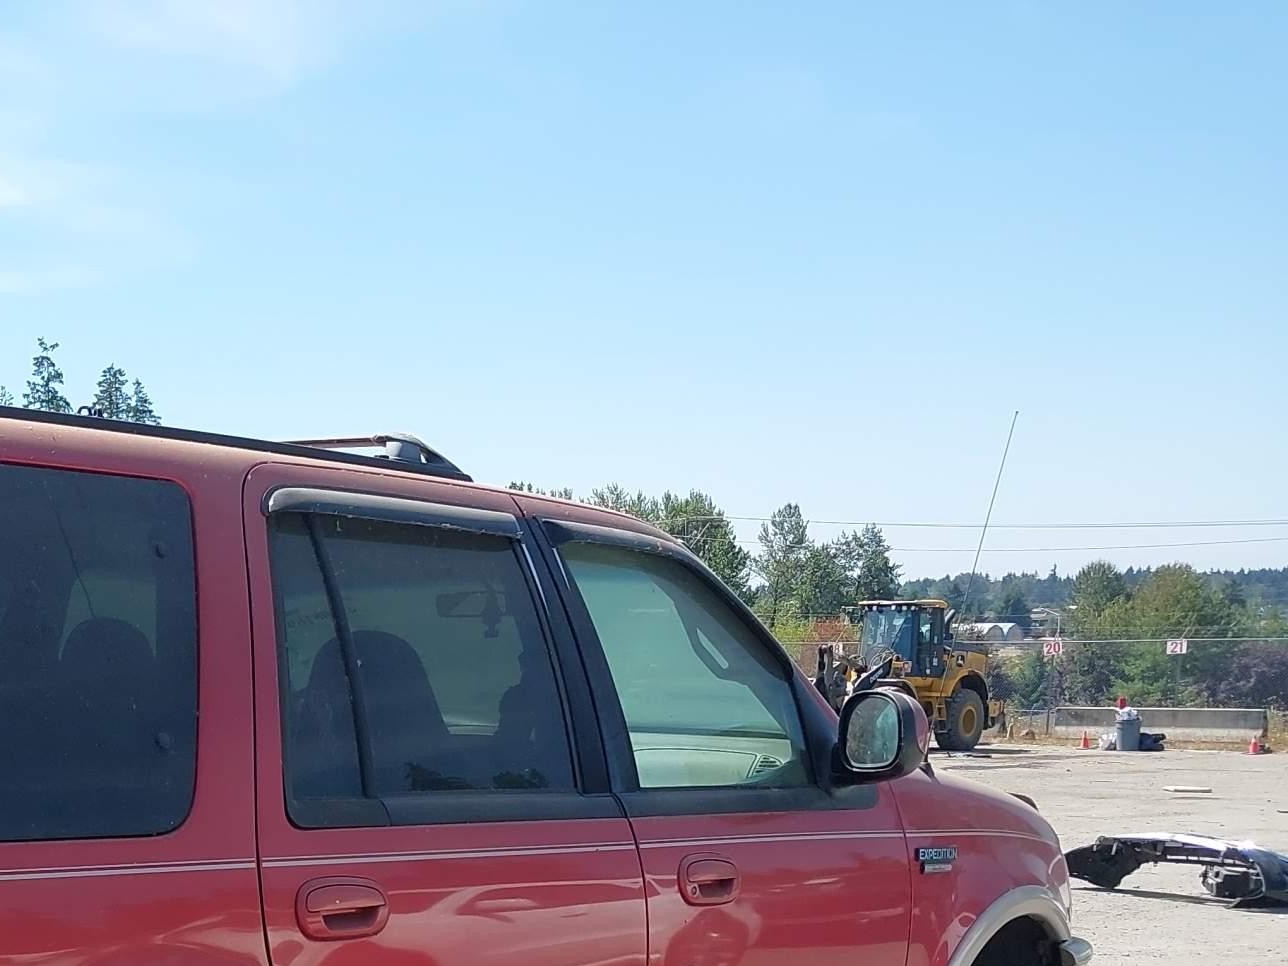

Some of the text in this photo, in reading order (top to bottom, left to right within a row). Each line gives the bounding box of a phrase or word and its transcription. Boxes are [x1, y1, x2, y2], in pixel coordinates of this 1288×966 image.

[1045, 641, 1061, 655] 20
[1171, 641, 1183, 654] 21
[919, 847, 958, 860] EXPEDITION
